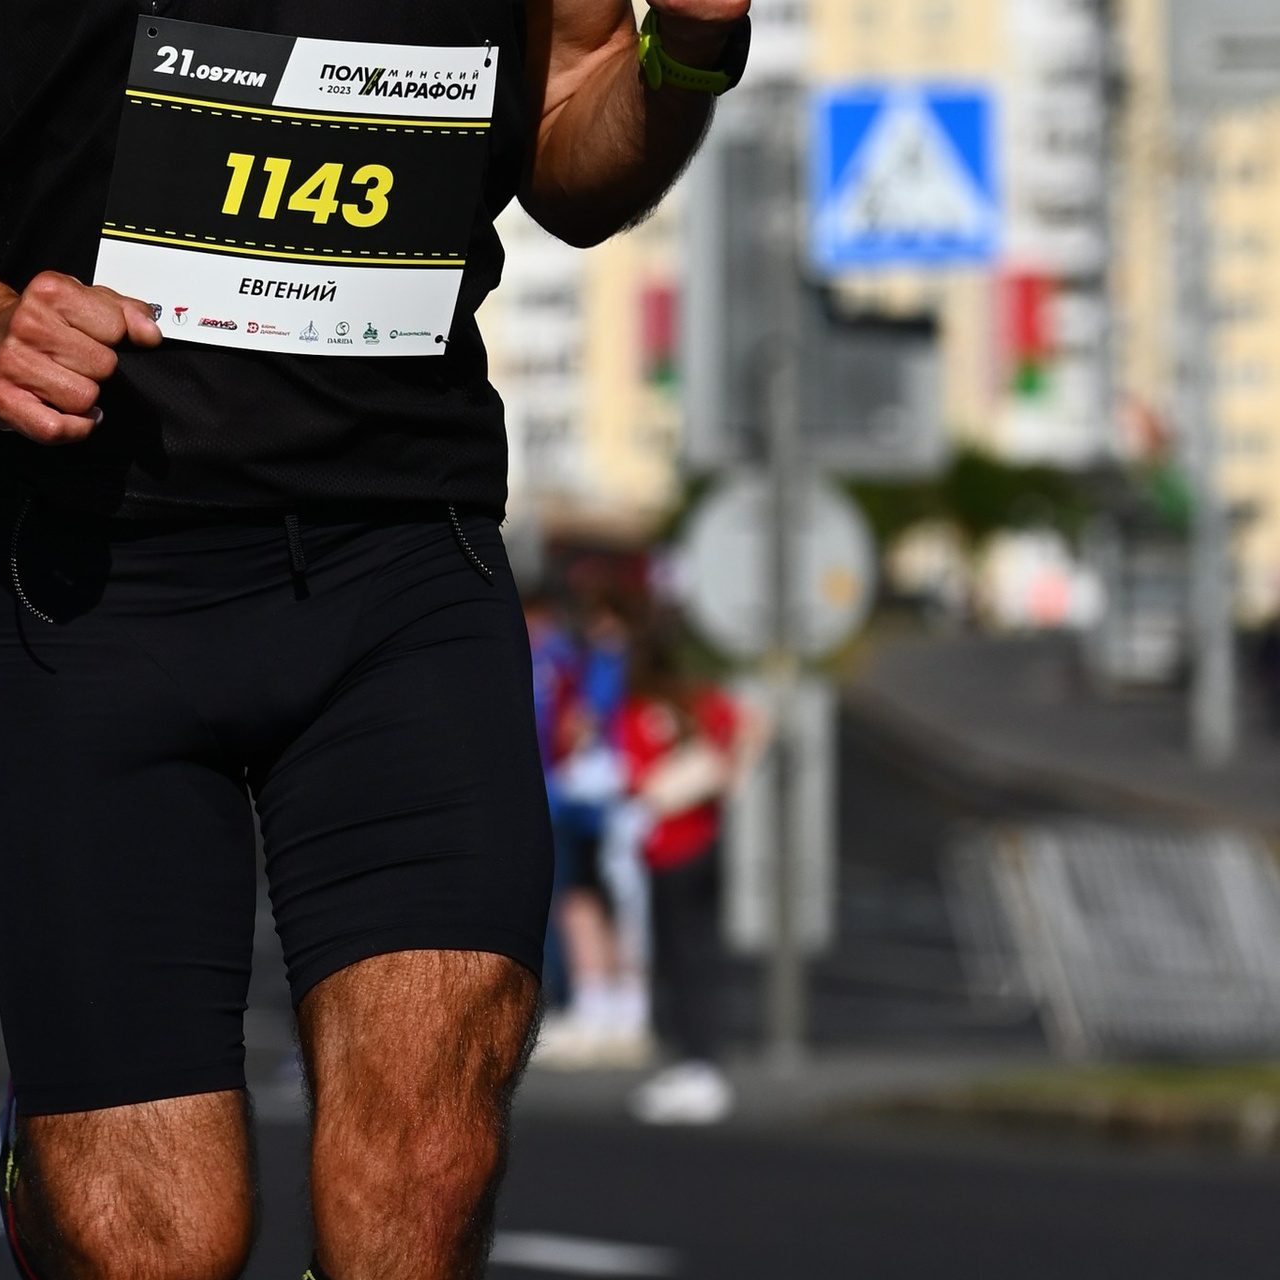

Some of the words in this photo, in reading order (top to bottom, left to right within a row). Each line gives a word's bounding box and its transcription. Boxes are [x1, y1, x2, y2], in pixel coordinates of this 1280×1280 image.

[320, 64, 386, 90] ПОЛУ
[387, 69, 480, 80] МИНСКИЙ
[327, 85, 351, 95] 2023
[368, 81, 477, 100] МАРАФОН
[221, 152, 394, 228] 1143
[238, 276, 338, 302] ЕВГЕНИЙ
